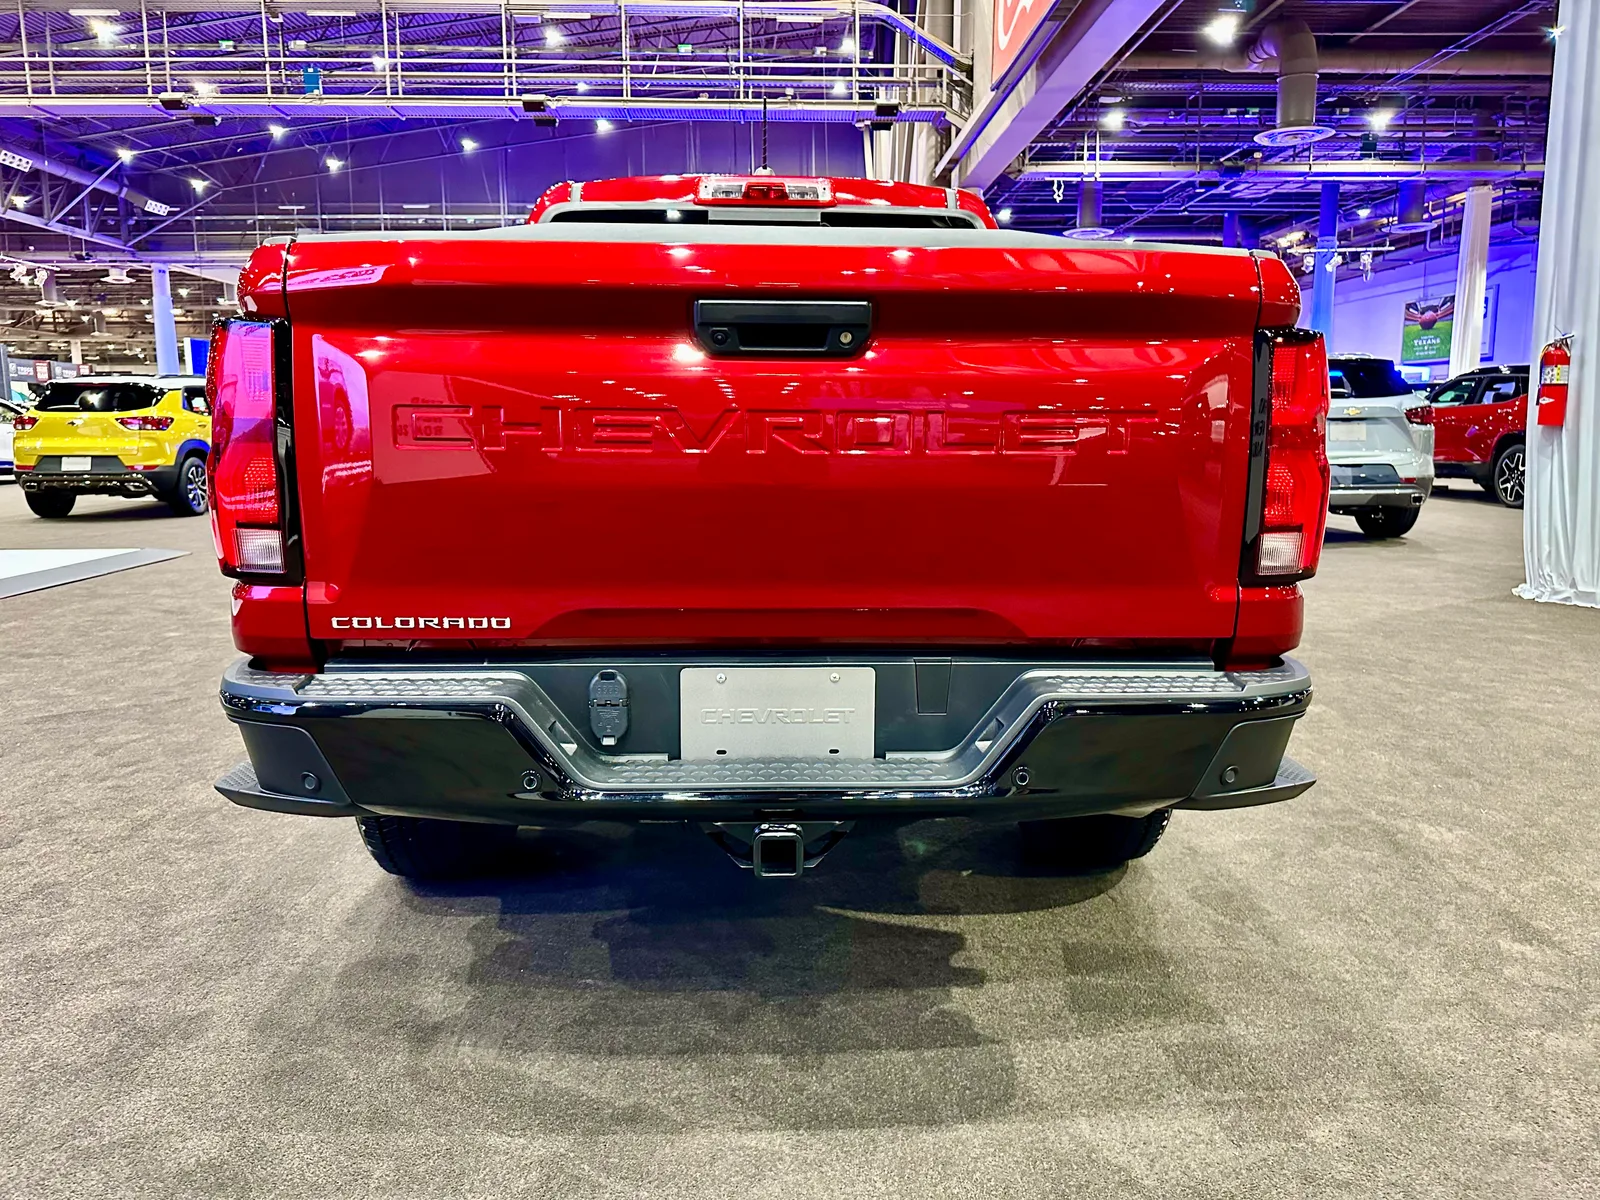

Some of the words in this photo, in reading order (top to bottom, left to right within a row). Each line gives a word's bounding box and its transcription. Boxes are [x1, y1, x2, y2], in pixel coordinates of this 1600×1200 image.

[1413, 337, 1440, 346] TEXANS
[392, 403, 1158, 455] CHEVROLET
[331, 616, 511, 629] COLORADO
[700, 707, 856, 725] CHEVROLET
